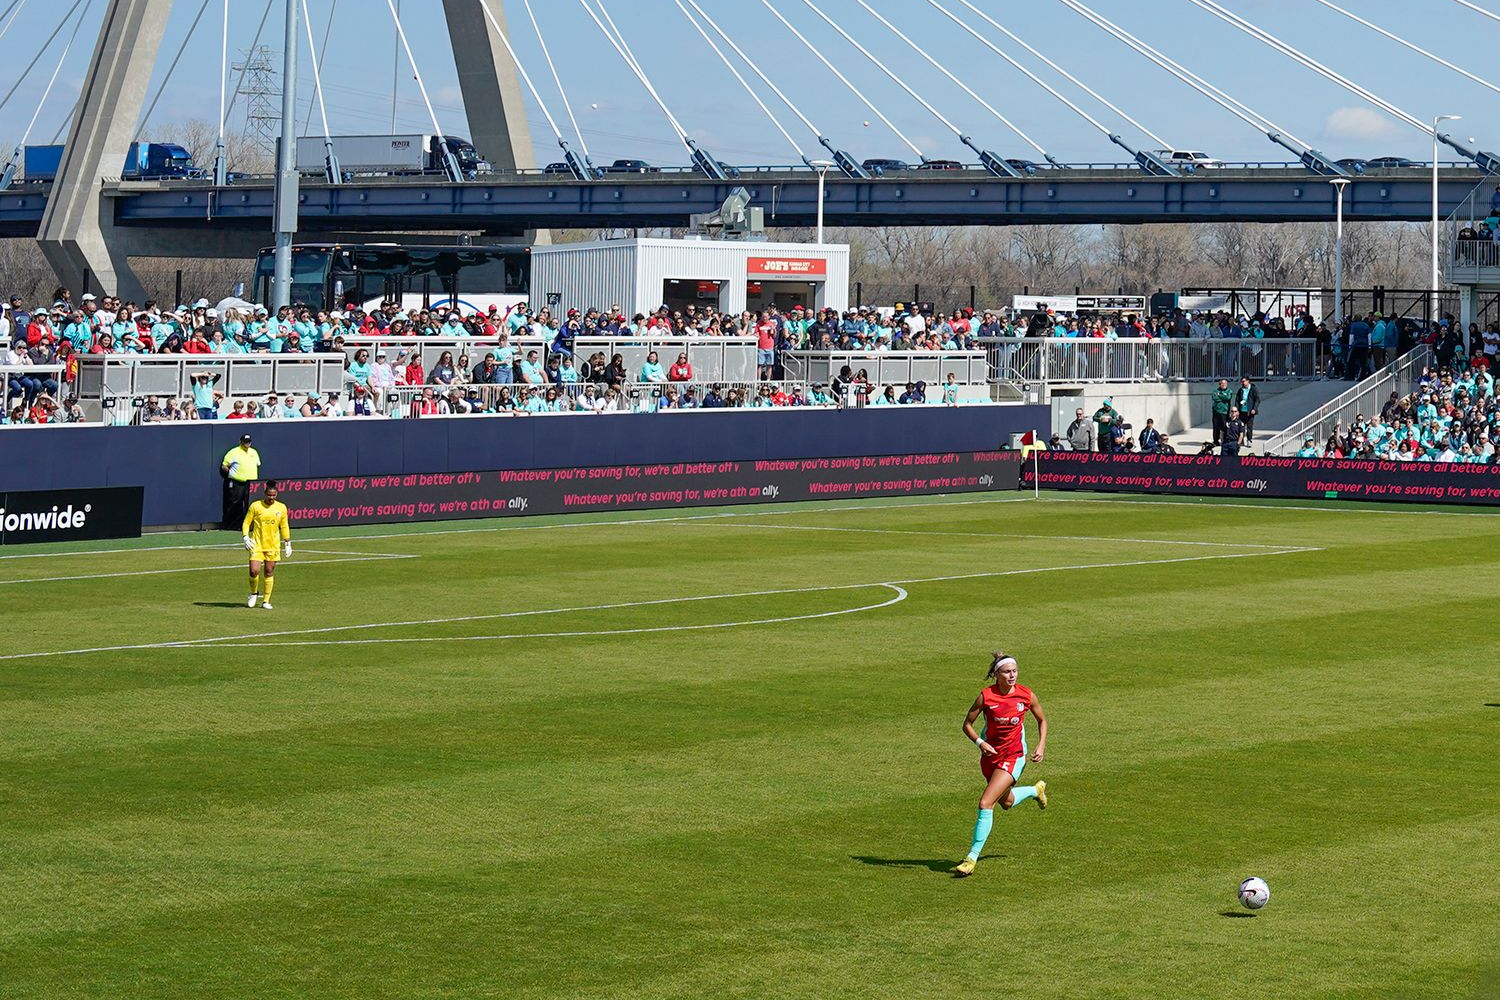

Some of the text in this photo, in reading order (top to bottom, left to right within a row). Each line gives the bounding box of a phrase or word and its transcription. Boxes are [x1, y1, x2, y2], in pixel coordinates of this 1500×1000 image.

[764, 260, 789, 271] JOE'S
[1053, 452, 1213, 464] saving for, we're all better off
[1241, 457, 1296, 467] Whatever
[1298, 459, 1334, 469] you're
[1337, 460, 1375, 472] saving
[1379, 461, 1397, 472] for,
[1401, 462, 1431, 472] we're
[1433, 463, 1447, 472] all
[1450, 463, 1488, 473] better
[500, 462, 733, 483] Whatever you're saving for, we're all better off
[305, 472, 474, 492] saving for, we're all better off
[1079, 475, 1113, 484] you're
[1116, 476, 1152, 488] saving
[1155, 476, 1173, 487] for,
[1177, 478, 1205, 487] we're
[1231, 480, 1245, 488] an
[1246, 479, 1267, 491] ally.
[1307, 481, 1362, 493] Whatever
[1366, 484, 1402, 495] you're
[1405, 486, 1445, 498] saving
[1447, 486, 1466, 497] for,
[1471, 488, 1500, 498] we're
[564, 494, 612, 505] Whatever
[616, 492, 648, 504] you're
[650, 491, 682, 502] saving
[685, 489, 701, 499] for,
[704, 488, 728, 499] we're
[748, 488, 760, 497] an
[762, 485, 779, 498] ally.
[286, 506, 334, 520] hatever
[338, 505, 373, 520] you're
[377, 504, 414, 516] saving
[418, 503, 436, 514] for,
[440, 501, 467, 512] we're
[492, 499, 506, 510] an
[508, 497, 527, 511] ally.
[1001, 761, 1010, 772] 5
